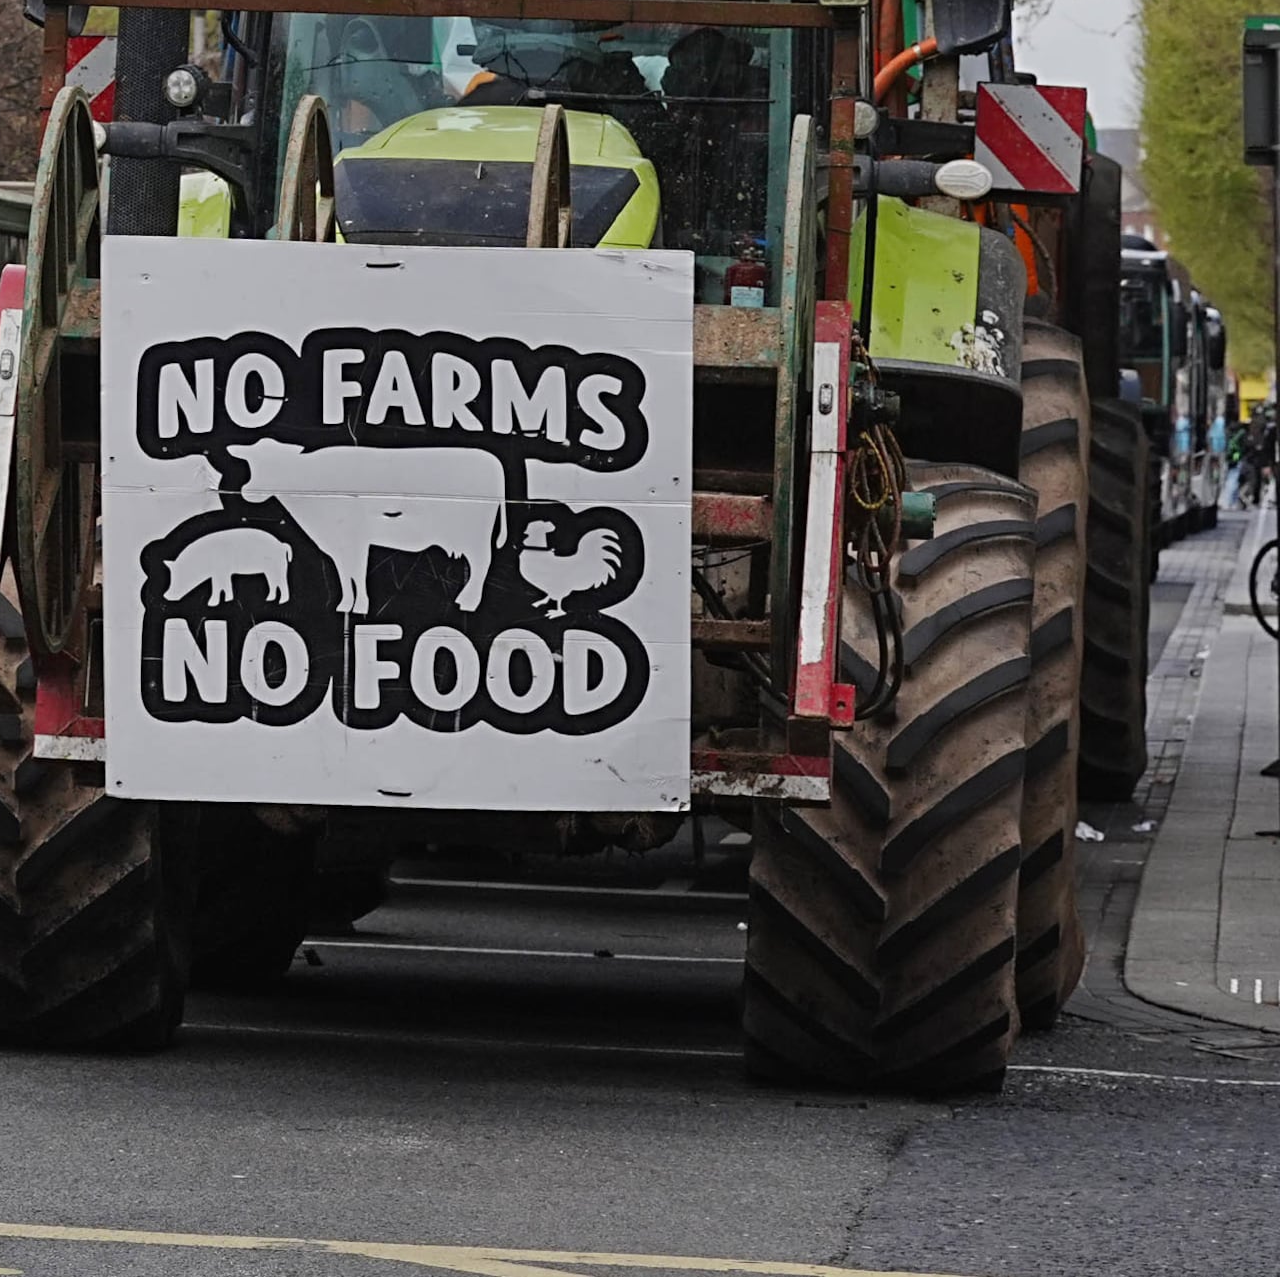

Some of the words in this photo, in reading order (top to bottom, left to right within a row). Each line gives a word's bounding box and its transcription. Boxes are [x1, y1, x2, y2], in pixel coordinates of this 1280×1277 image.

[158, 353, 286, 439] NO
[322, 349, 626, 451] FARMS
[162, 617, 309, 707] NO
[354, 625, 627, 717] FOOD
